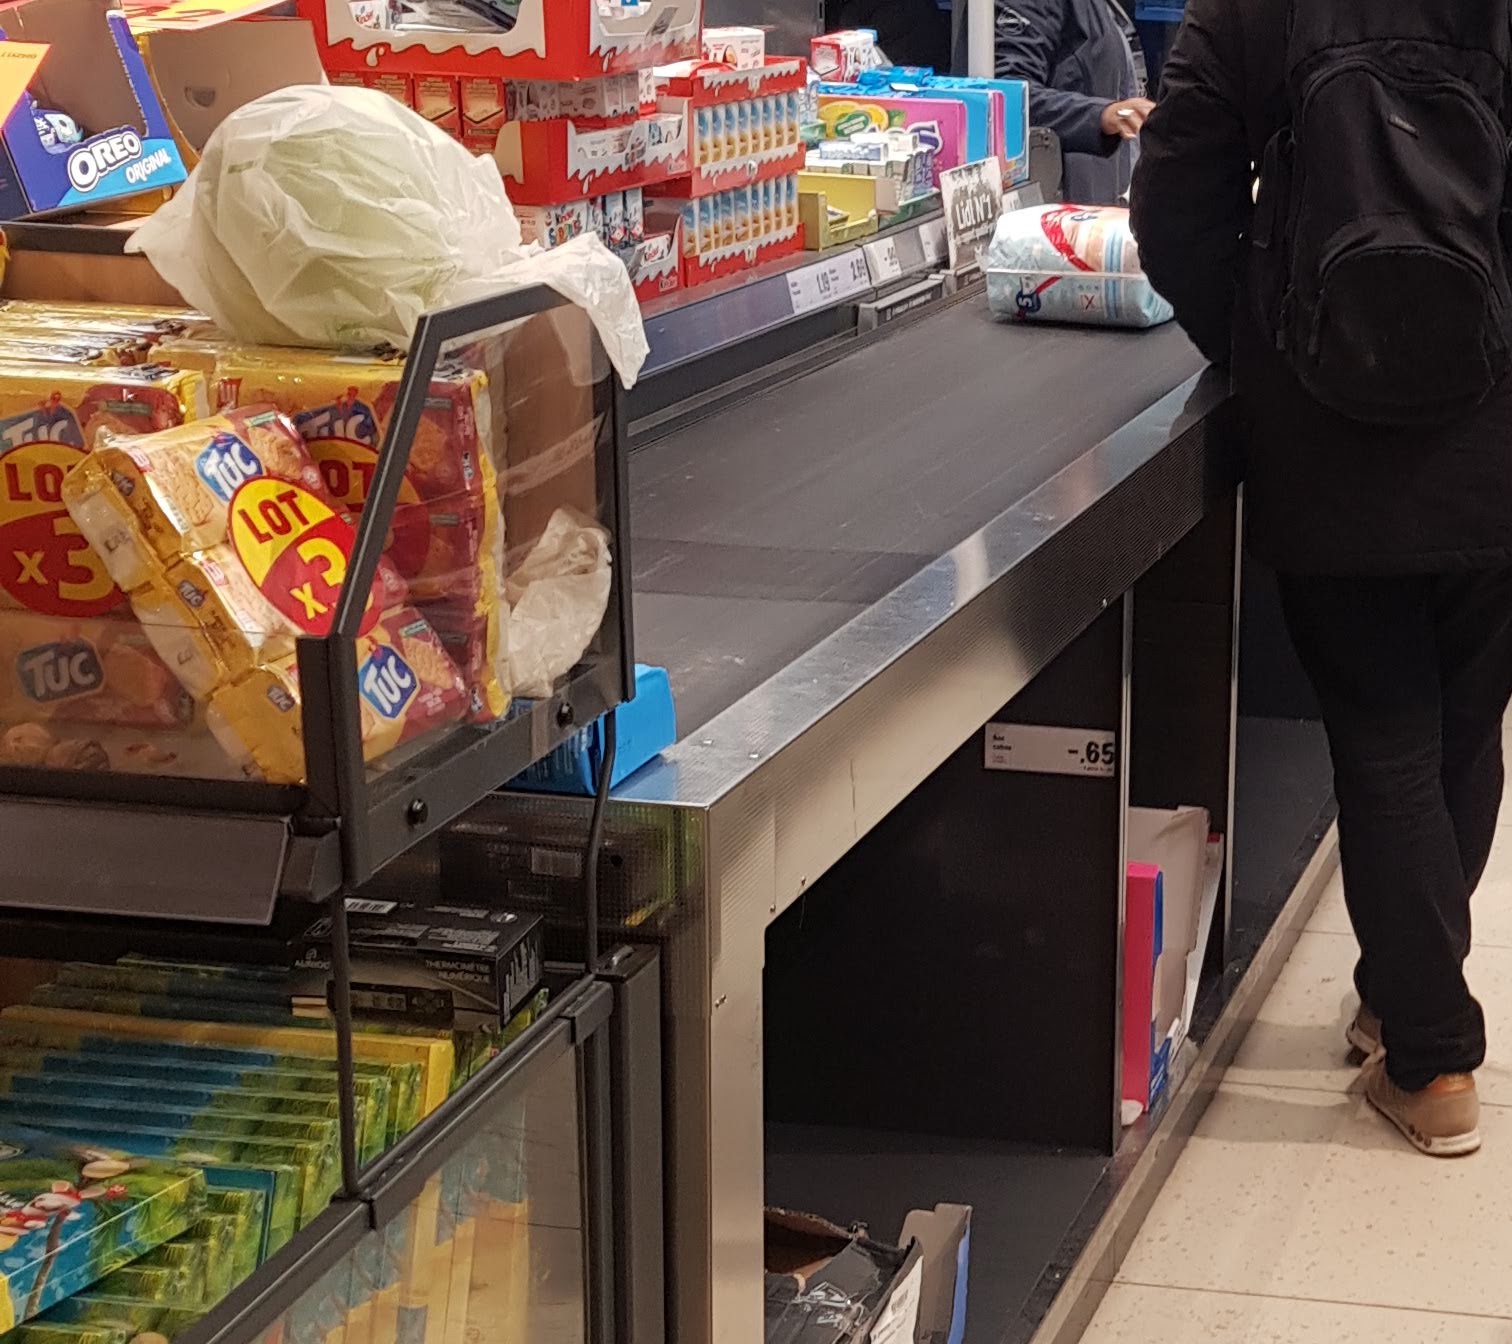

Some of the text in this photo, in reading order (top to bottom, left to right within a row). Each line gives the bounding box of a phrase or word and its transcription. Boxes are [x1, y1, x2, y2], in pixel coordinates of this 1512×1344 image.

[68, 131, 142, 193] OREO
[125, 148, 172, 184] ORIGINAL
[956, 203, 975, 230] Lidl
[5, 463, 75, 503] LO
[204, 442, 258, 500] TUC
[238, 490, 311, 545] LOT
[27, 649, 97, 697] TUC
[361, 654, 413, 714] TUC
